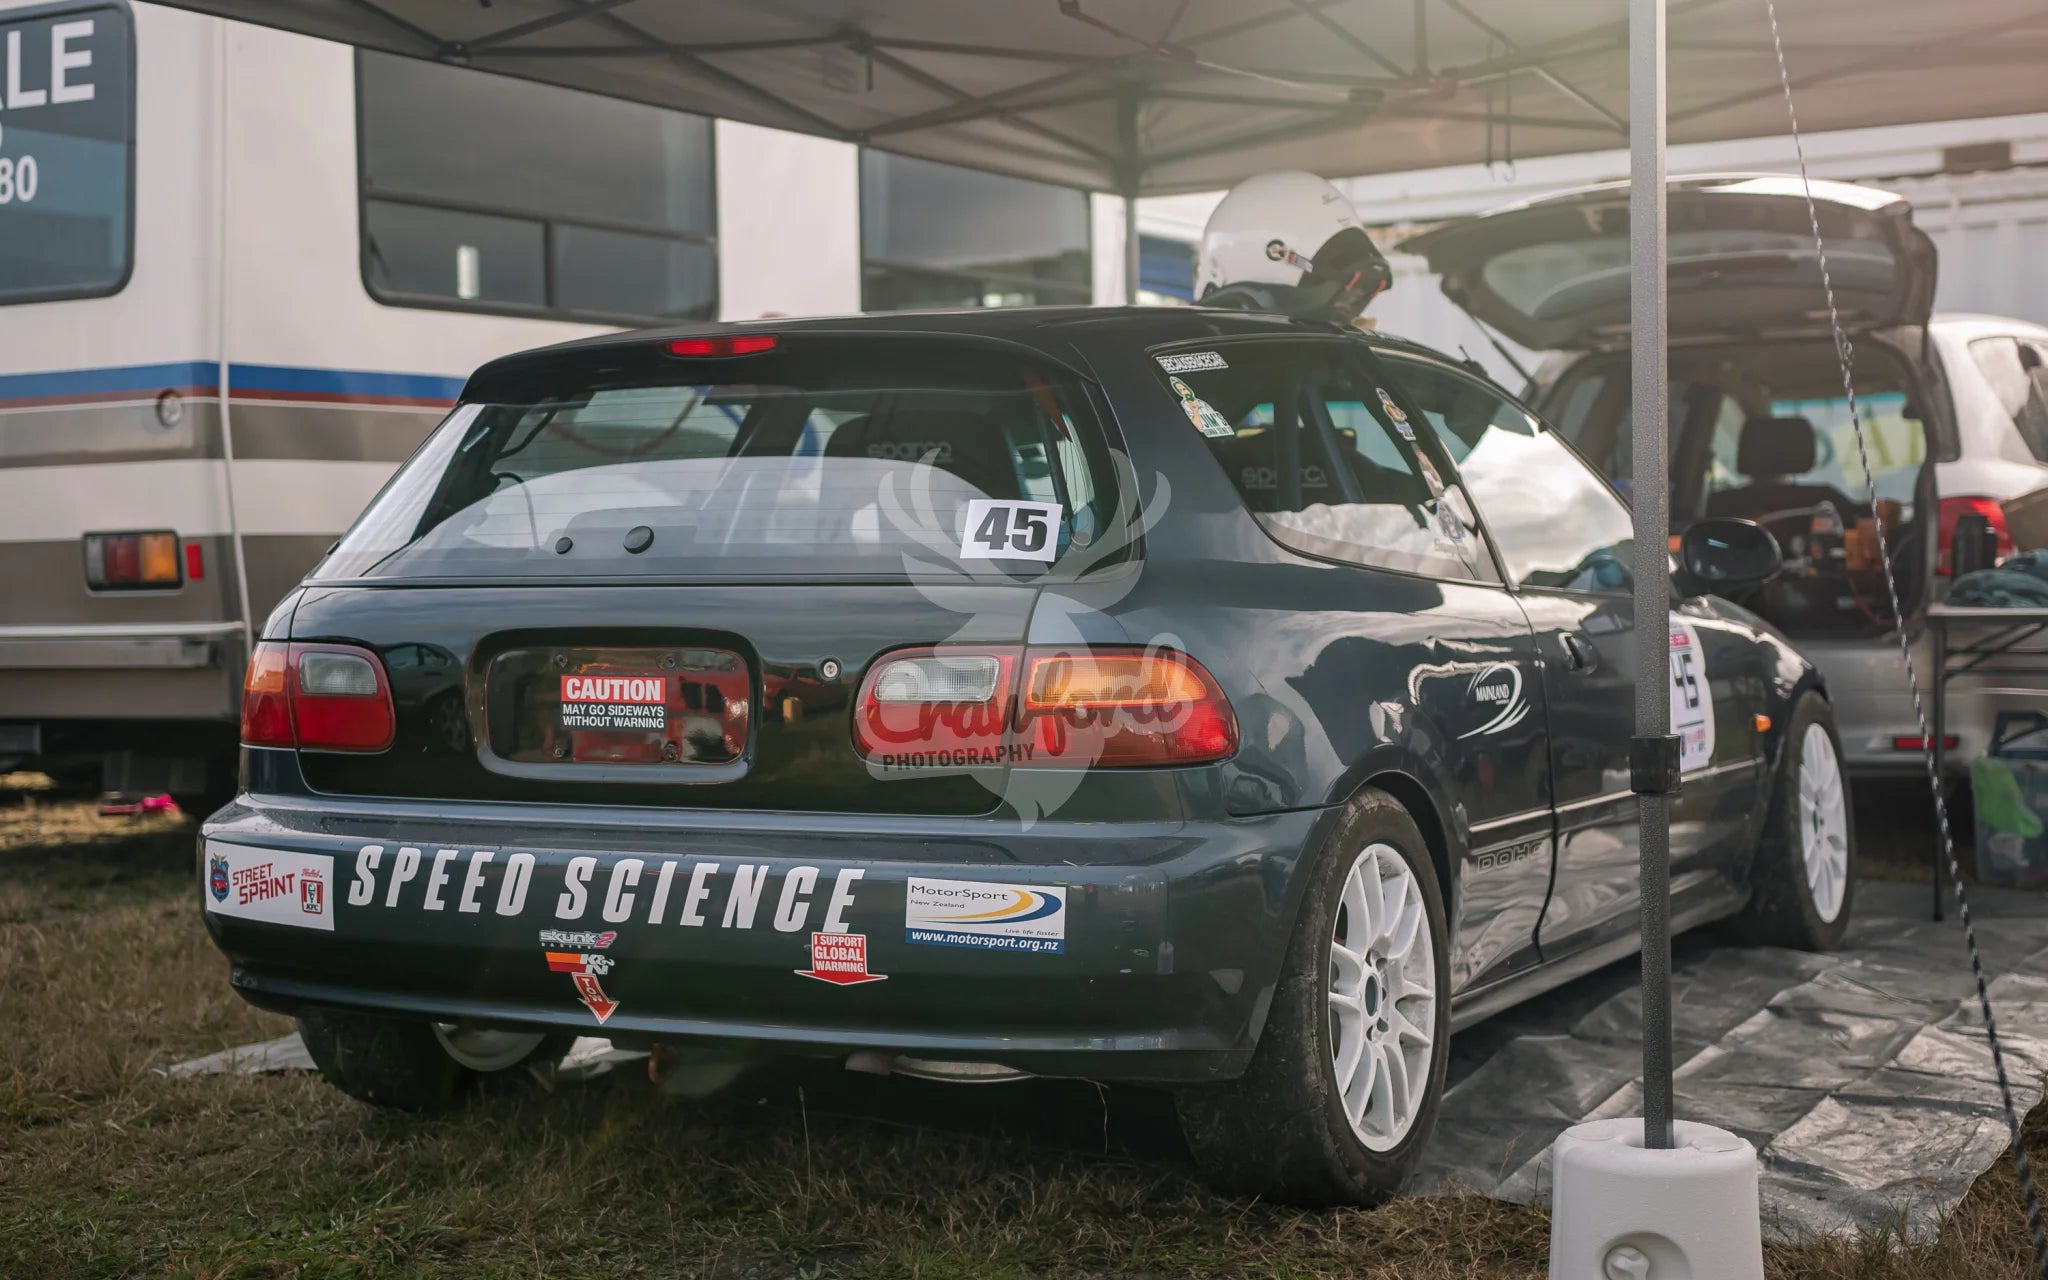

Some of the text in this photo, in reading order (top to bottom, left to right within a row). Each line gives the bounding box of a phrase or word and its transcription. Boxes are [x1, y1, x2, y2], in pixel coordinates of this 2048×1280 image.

[0, 19, 95, 110] LE
[974, 507, 1048, 552] 45
[566, 678, 661, 701] CAUTION
[1670, 654, 1698, 709] 45
[1475, 684, 1510, 702] MAINLAND
[562, 703, 665, 717] MAY GO SIDEWAYS
[562, 715, 665, 729] WITHOUT WARNING
[232, 862, 274, 887] STREET
[239, 873, 296, 906] SPRINT
[347, 845, 866, 934] SPEED SCIENCE
[911, 885, 1008, 901] MotorSport
[305, 903, 320, 911] KFC
[933, 901, 965, 909] Zealand
[813, 934, 863, 947] I SUPPORT
[911, 931, 1058, 951] www.motorsport.org.nz
[814, 946, 864, 962] GLOBAL
[815, 960, 864, 973] WARMING
[581, 977, 603, 1003] TOW
